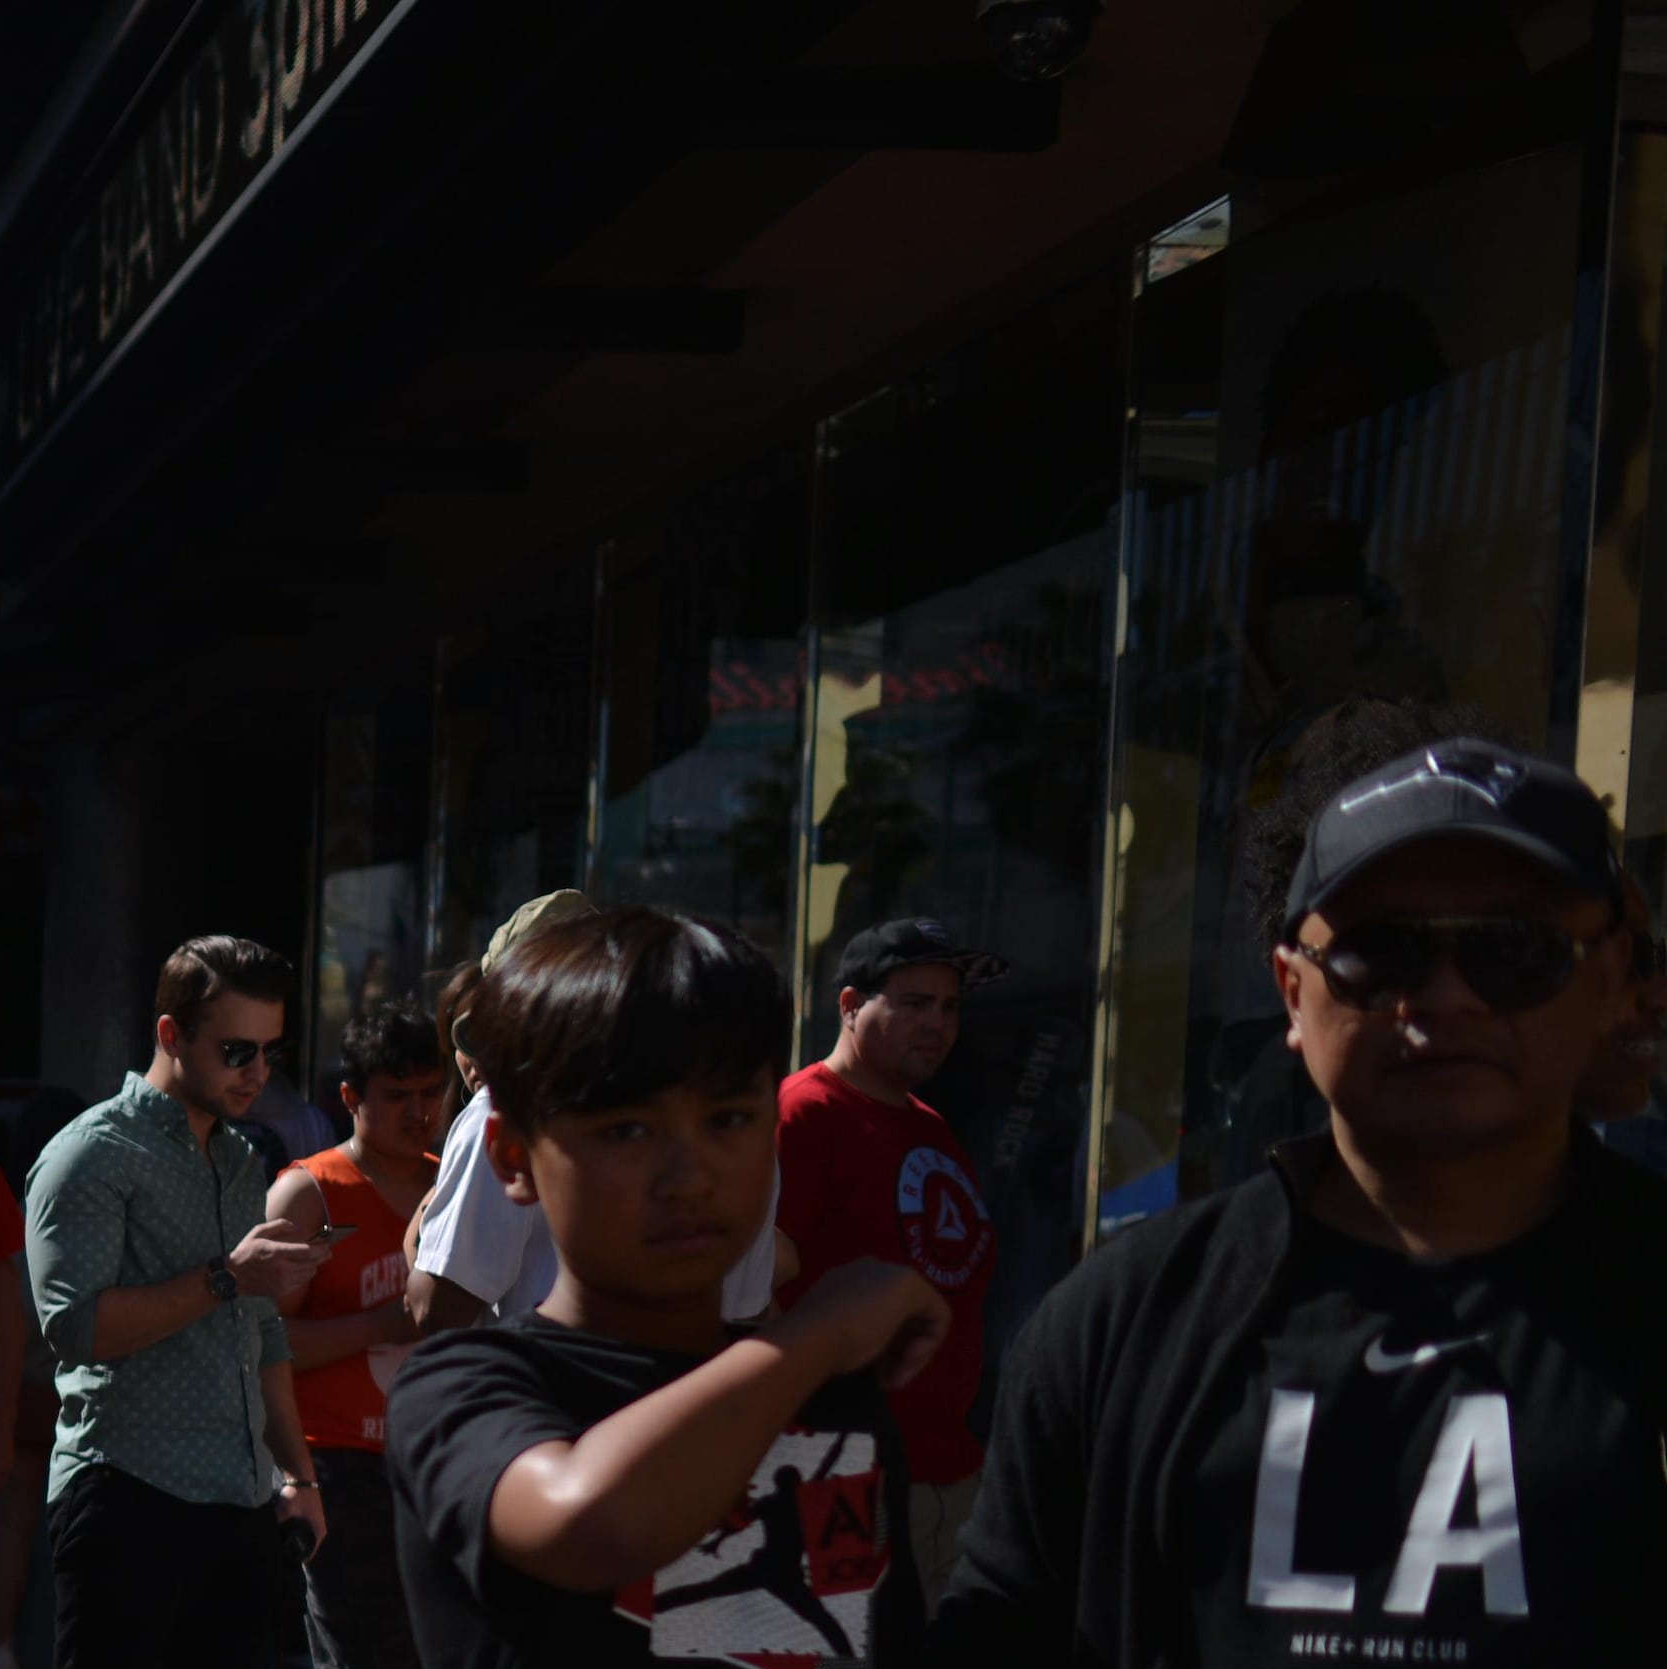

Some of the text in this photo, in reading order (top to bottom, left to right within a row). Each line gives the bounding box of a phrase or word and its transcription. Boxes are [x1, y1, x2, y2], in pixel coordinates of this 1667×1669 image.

[98, 33, 225, 343] BAND
[1245, 1387, 1529, 1617] LA
[1289, 1632, 1467, 1662] NIKE+ RUN CLUB
